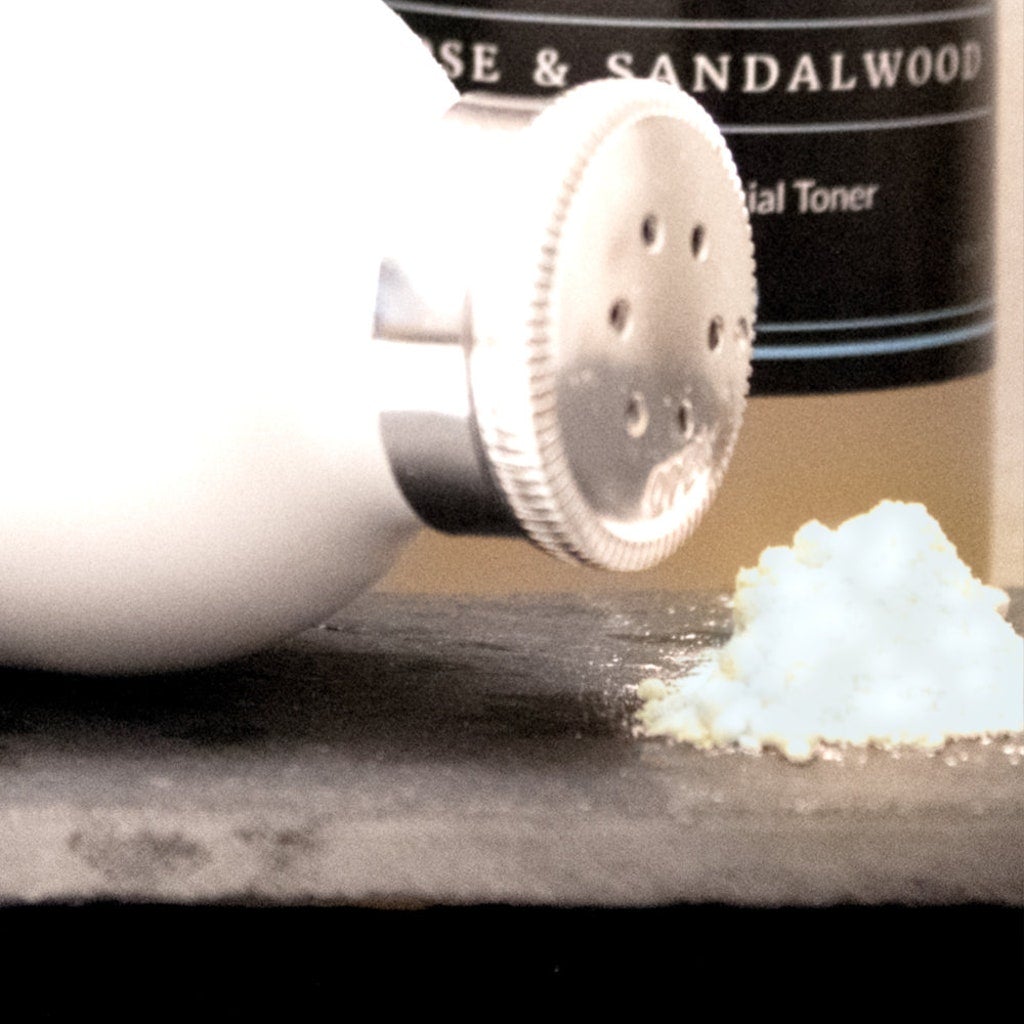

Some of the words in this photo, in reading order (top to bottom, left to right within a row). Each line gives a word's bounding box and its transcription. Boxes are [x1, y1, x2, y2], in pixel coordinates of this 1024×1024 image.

[423, 36, 501, 83] SE
[533, 46, 569, 87] &
[606, 40, 982, 93] SANDALWOOD
[747, 179, 785, 215] ial
[792, 178, 879, 214] Toner
